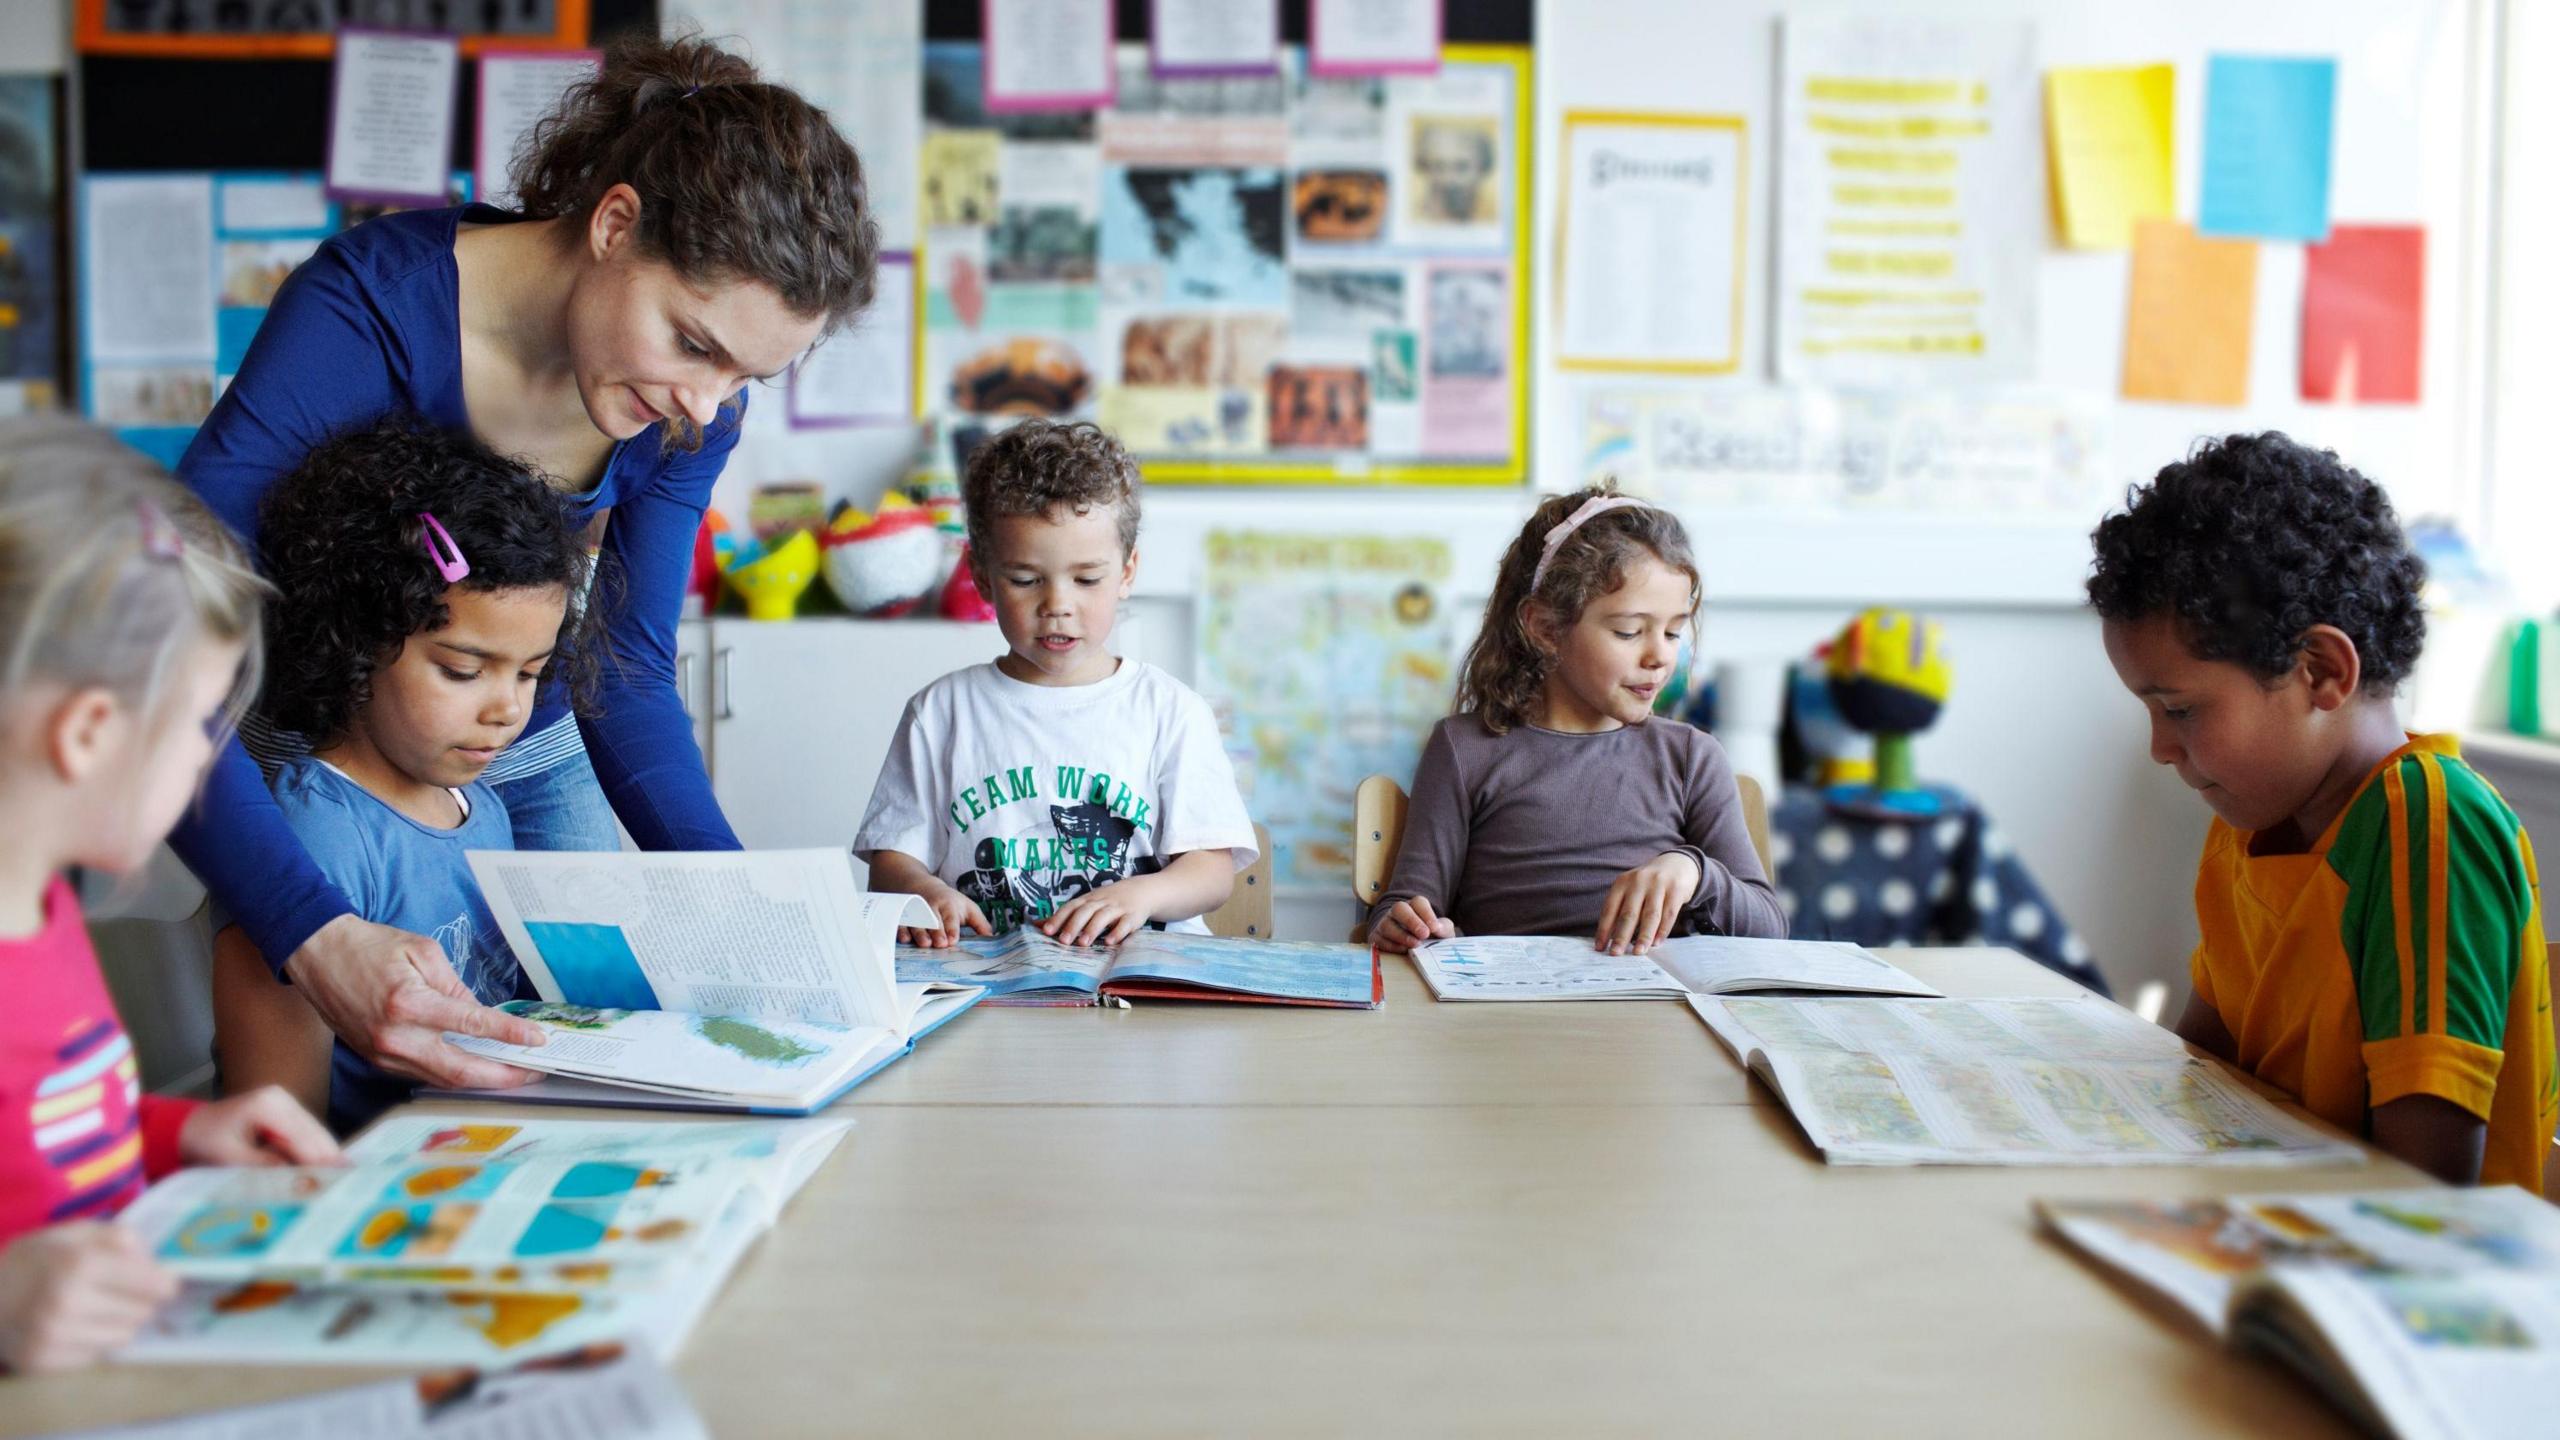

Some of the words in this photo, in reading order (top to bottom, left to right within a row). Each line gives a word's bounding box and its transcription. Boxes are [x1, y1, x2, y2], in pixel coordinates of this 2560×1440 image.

[951, 766, 1038, 834] TEAM
[1057, 766, 1150, 831] WORK
[992, 837, 1111, 871] MAKES
